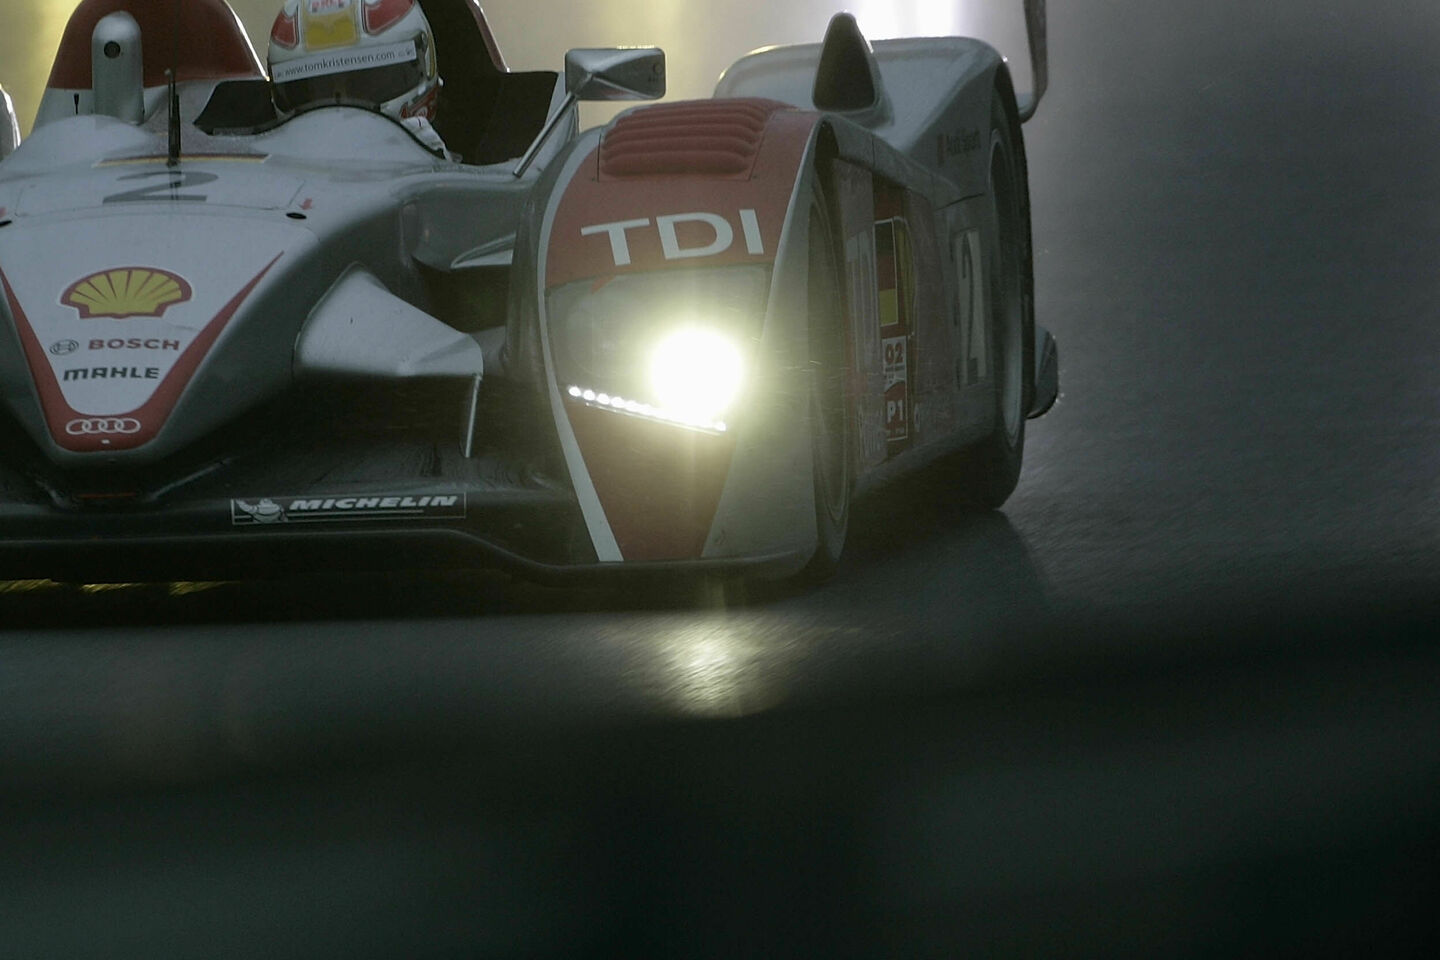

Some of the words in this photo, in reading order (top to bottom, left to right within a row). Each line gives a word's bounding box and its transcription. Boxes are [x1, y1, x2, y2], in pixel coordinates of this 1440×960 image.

[285, 52, 396, 77] www.tomkristensen.com
[102, 171, 219, 204] 2
[580, 208, 765, 266] TDI
[88, 338, 180, 350] BOSCH
[885, 342, 904, 364] 02
[63, 367, 160, 381] MAHLE
[887, 398, 904, 424] P1
[289, 496, 458, 510] MICHELIN
